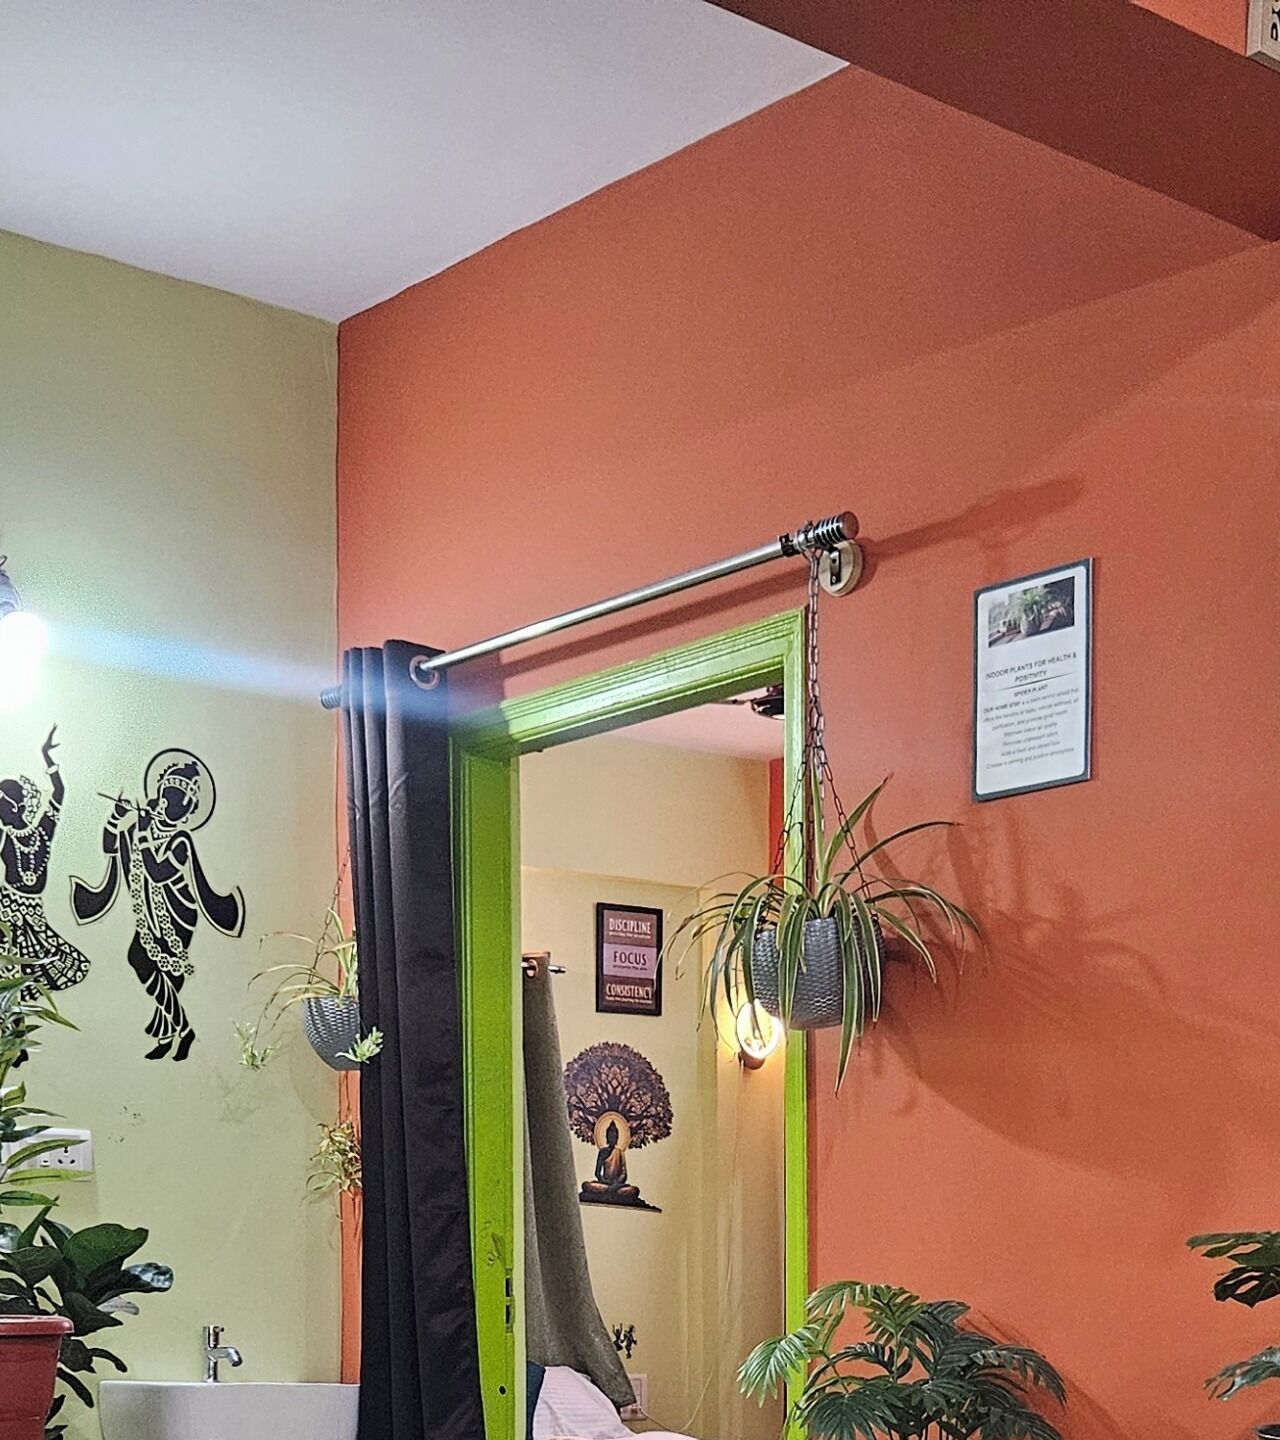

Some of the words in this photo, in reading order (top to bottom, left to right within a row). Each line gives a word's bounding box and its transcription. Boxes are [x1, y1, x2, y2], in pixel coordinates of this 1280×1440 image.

[986, 669, 1008, 680] INDOOR
[1010, 663, 1033, 674] PLANTS
[1035, 659, 1046, 668] FOR
[1048, 653, 1070, 665] HEALTH
[1015, 669, 1047, 683] POSITIVITY
[609, 918, 651, 934] DISCIPLINE
[613, 951, 646, 966] FOCUS
[606, 984, 652, 999] CONSISTENCY
